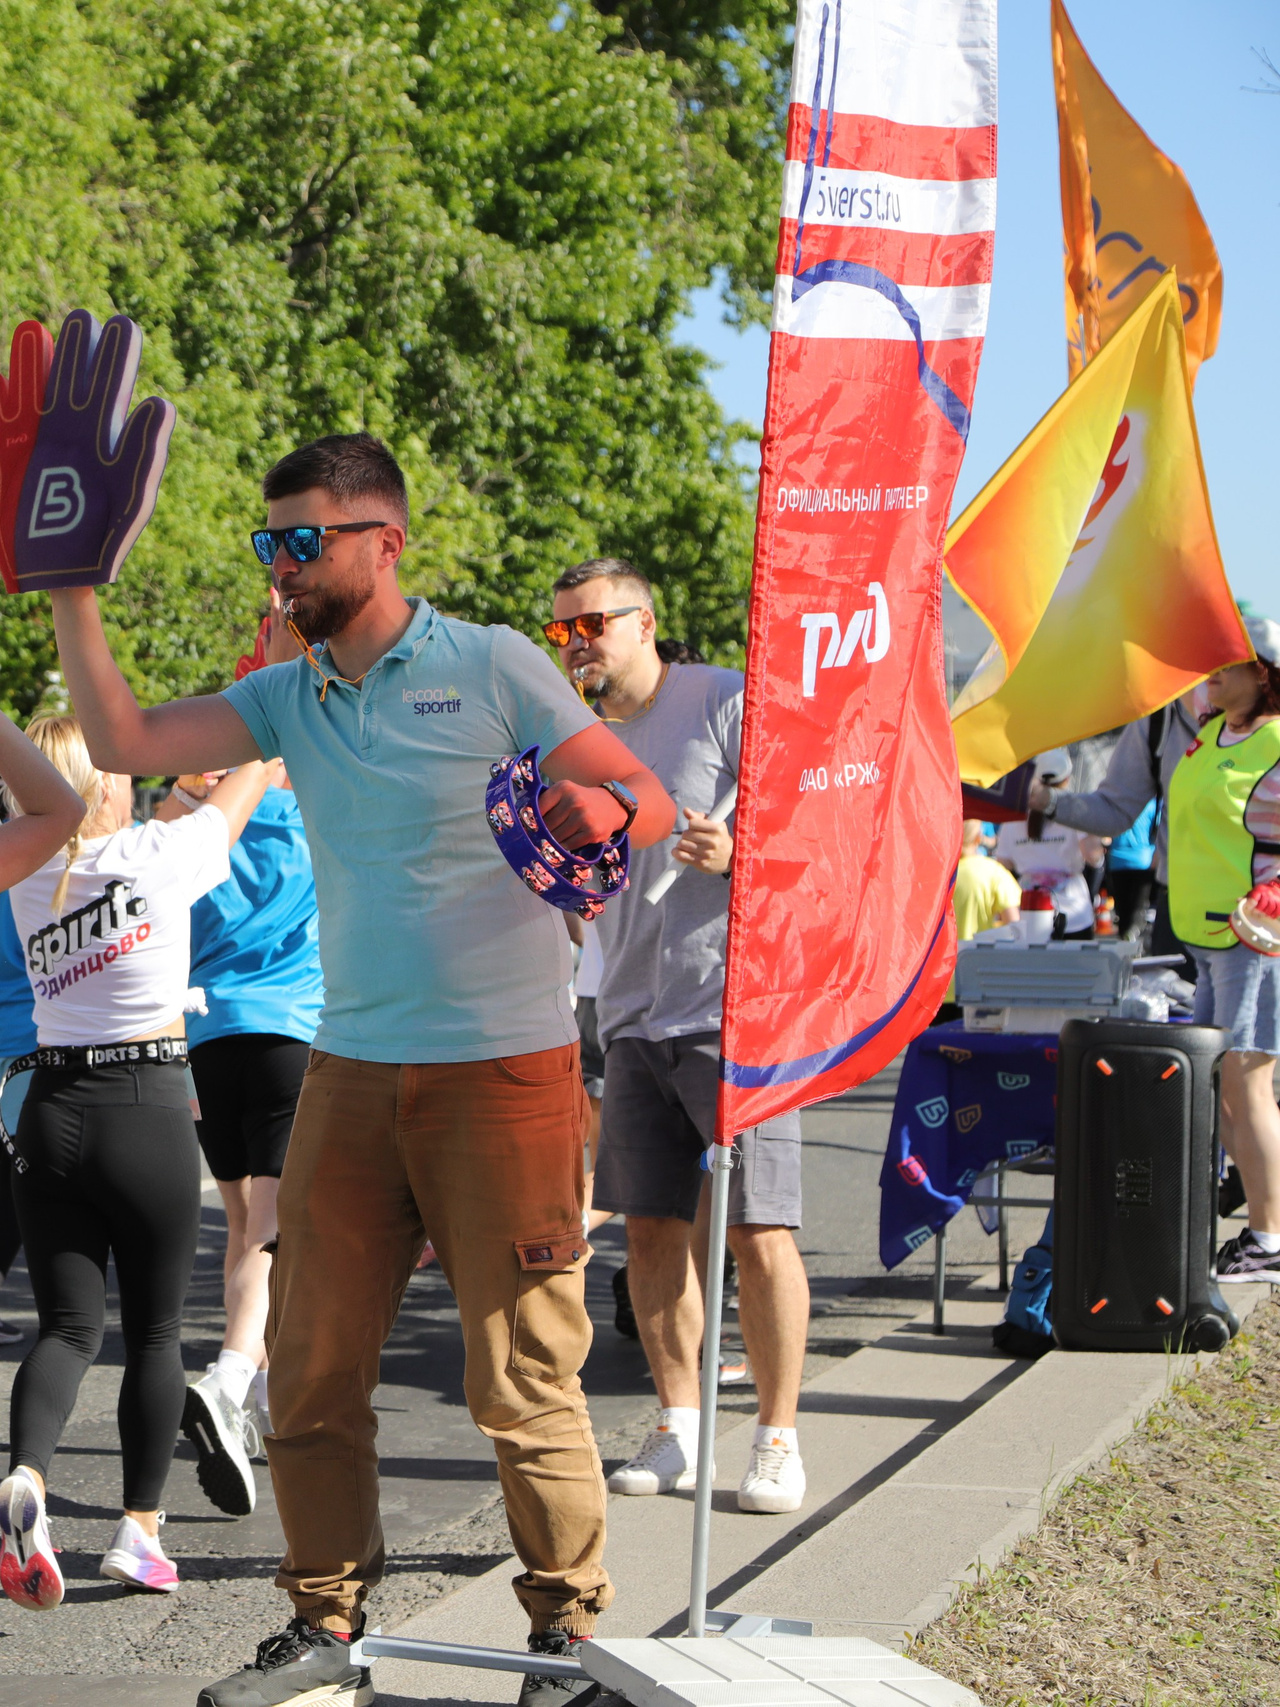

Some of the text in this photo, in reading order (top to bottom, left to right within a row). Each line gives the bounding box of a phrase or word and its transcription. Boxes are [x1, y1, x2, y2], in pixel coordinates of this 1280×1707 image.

[817, 176, 901, 222] 5verst.ru
[777, 483, 929, 516] ОФИЦИАЛЬНЫЙ ПАРТНЕР
[402, 688, 414, 703] le
[413, 698, 461, 716] sportif
[799, 766, 828, 792] ОАО
